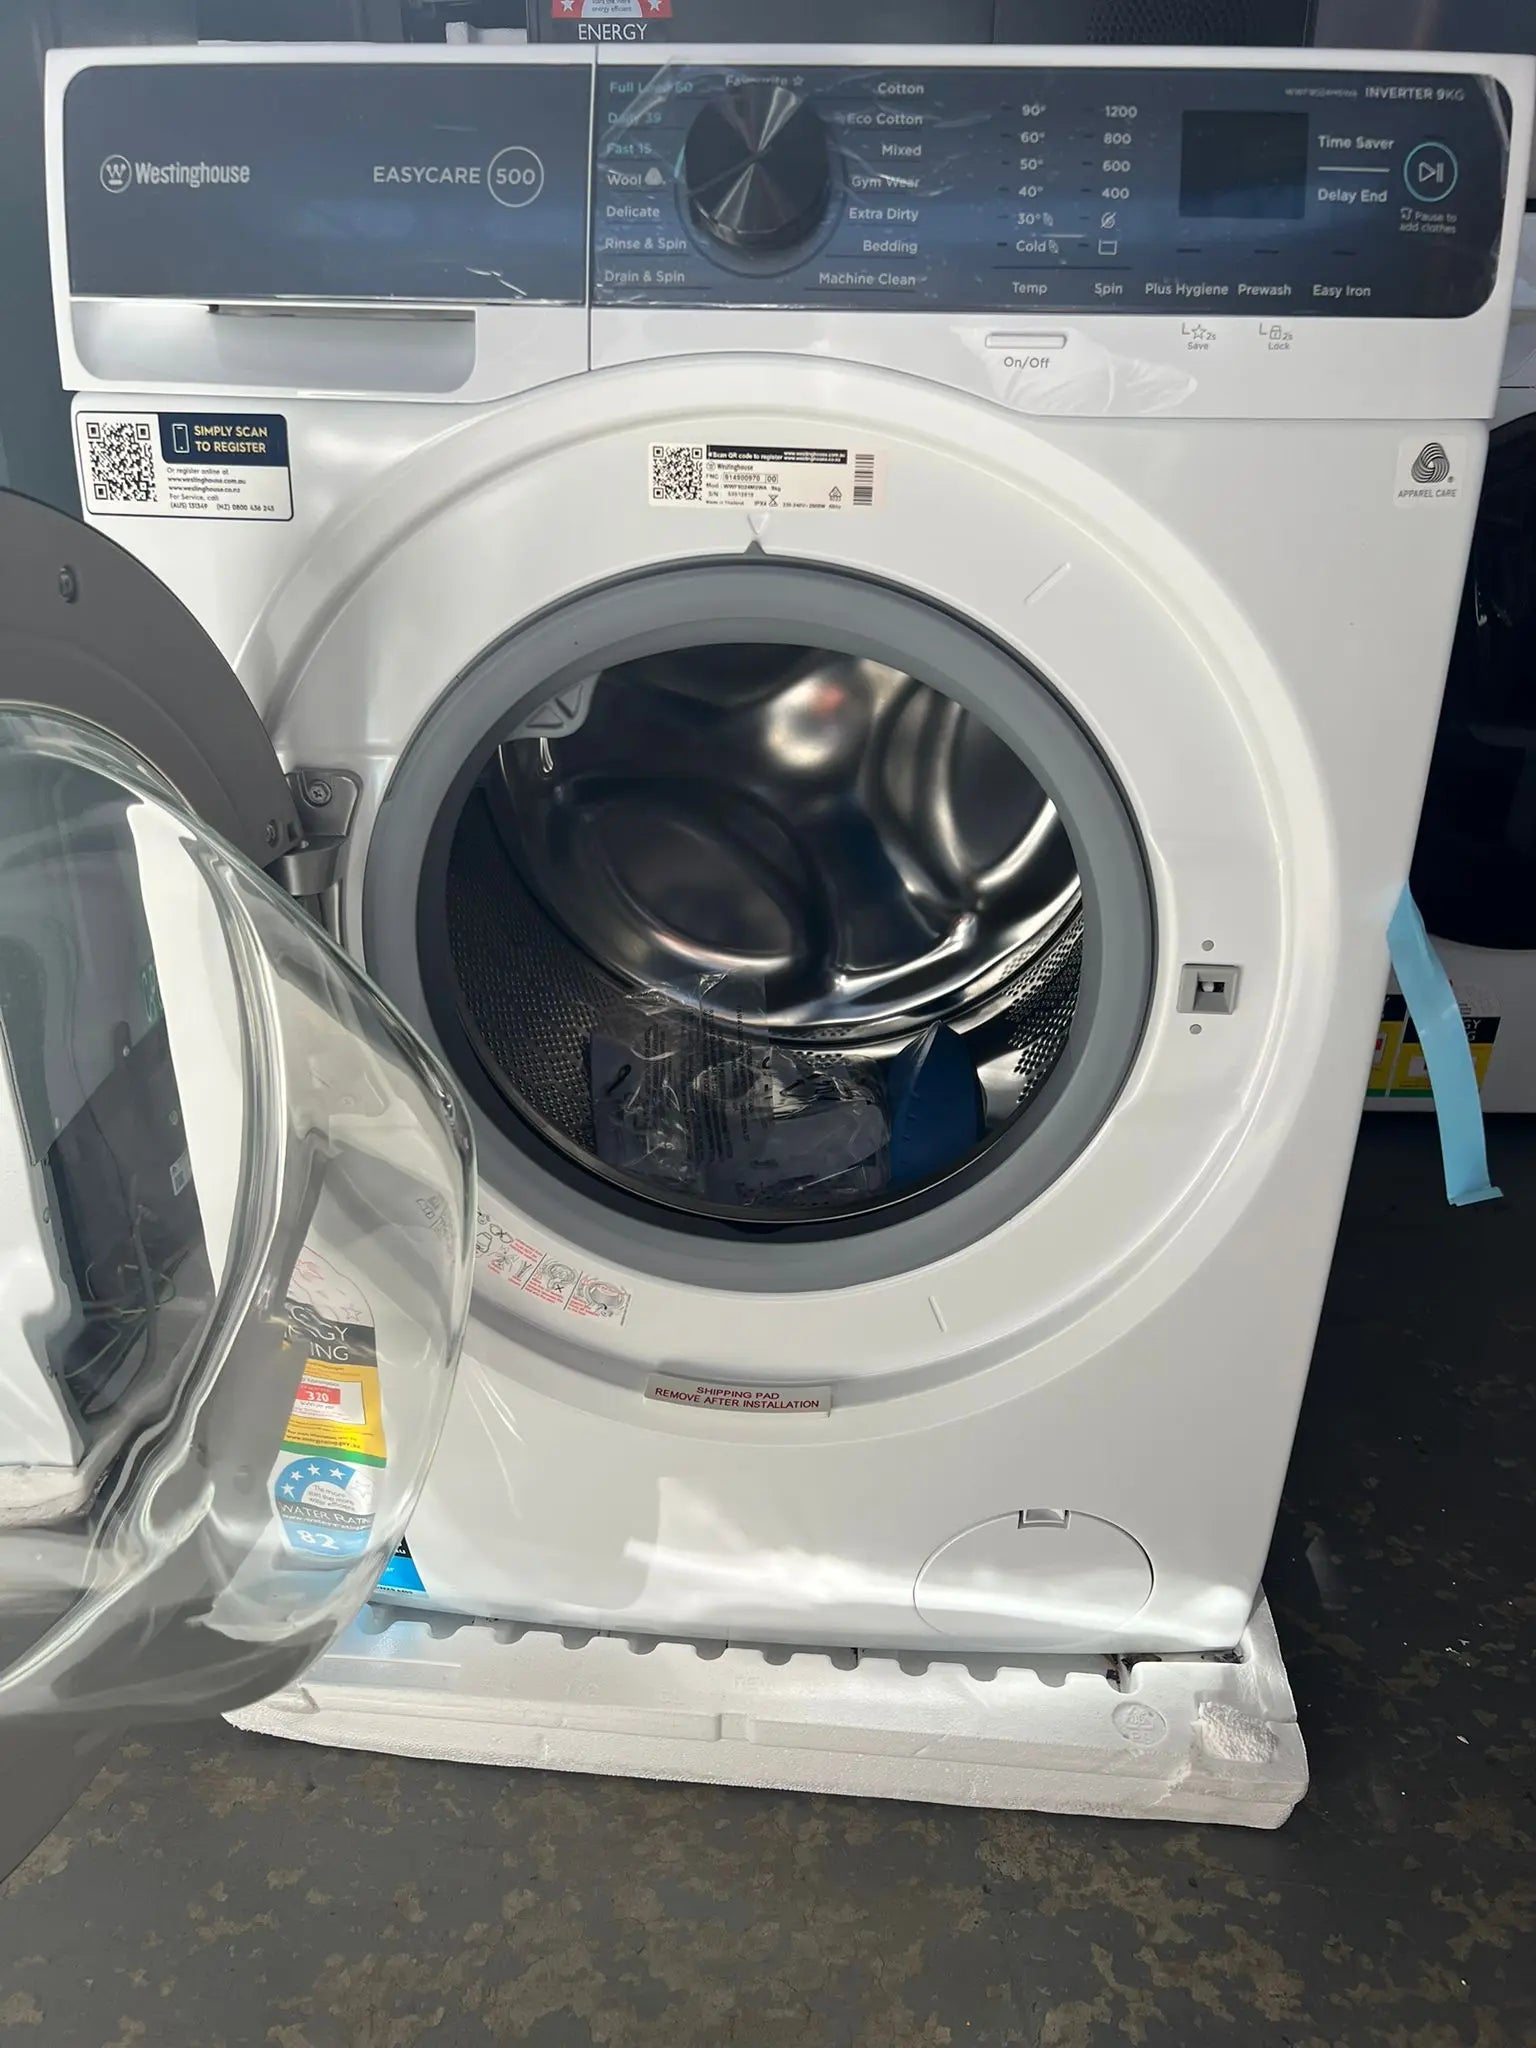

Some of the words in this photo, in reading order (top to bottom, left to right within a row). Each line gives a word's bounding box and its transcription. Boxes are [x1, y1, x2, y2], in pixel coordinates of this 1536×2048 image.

[578, 23, 648, 41] ENERGY
[609, 81, 635, 94] Full
[675, 81, 694, 93] 60
[878, 82, 925, 94] Cotton
[1365, 86, 1433, 100] INVERTER
[1436, 88, 1466, 101] 9KG
[1105, 105, 1138, 118] 1200
[846, 113, 873, 125] Eco
[876, 113, 923, 125] Cotton
[1103, 132, 1132, 145] 800
[1317, 135, 1352, 149] Time
[1355, 136, 1395, 150] Saver
[606, 143, 635, 155] Fast
[637, 143, 652, 155] 15
[881, 144, 922, 156] Mixed
[1102, 159, 1131, 172] 600
[134, 161, 251, 189] Westinghouse
[373, 165, 482, 185] EASYCARE
[495, 168, 537, 186] 500
[607, 174, 642, 186] Wool
[851, 176, 881, 190] Gym
[1101, 186, 1130, 199] 400
[1317, 188, 1357, 204] Delay
[1360, 189, 1388, 203] End
[606, 206, 661, 218] Delicate
[849, 207, 883, 220] Extra
[886, 207, 919, 222] Dirty
[1415, 211, 1444, 222] Pause
[1446, 213, 1458, 223] to
[1400, 222, 1419, 232] add
[1421, 223, 1456, 235] clothes
[604, 237, 641, 249] Rinse
[643, 238, 654, 249] &
[657, 238, 687, 252] Spin
[863, 240, 919, 255] Bedding
[1016, 239, 1046, 253] Cold
[604, 270, 639, 283] Drain
[642, 271, 652, 282] &
[656, 270, 686, 284] Spin
[819, 272, 874, 285] Machine
[878, 273, 916, 286] Clean
[1012, 281, 1049, 296] Temp
[1094, 282, 1124, 297] Spin
[1145, 283, 1172, 296] Plus
[1175, 283, 1229, 298] Hygiene
[1237, 284, 1293, 296] Prewash
[1312, 284, 1343, 298] Easy
[1346, 285, 1372, 297] Iron
[1187, 341, 1209, 351] Save
[1268, 341, 1291, 351] Lock
[1003, 355, 1050, 370] On/Off
[193, 425, 234, 437] SIMPLY
[236, 426, 268, 438] SCAN
[195, 441, 211, 452] TO
[214, 441, 266, 454] REGISTER
[176, 467, 200, 476] register
[717, 463, 754, 471] Westinghouse
[167, 476, 246, 485] www.westinghouse.com.au
[168, 485, 241, 494] www.westinghouse.co.nz
[1397, 489, 1433, 498] APPAREL
[1435, 489, 1457, 498] CARE
[306, 1390, 329, 1402] 320
[655, 1387, 701, 1403] REMOVE
[703, 1396, 739, 1407] AFTER
[743, 1399, 820, 1409] INSTALLATION
[696, 1386, 752, 1399] SHIPPING
[755, 1392, 780, 1400] PAD
[280, 1503, 331, 1521] WATER
[296, 1528, 340, 1550] 82
